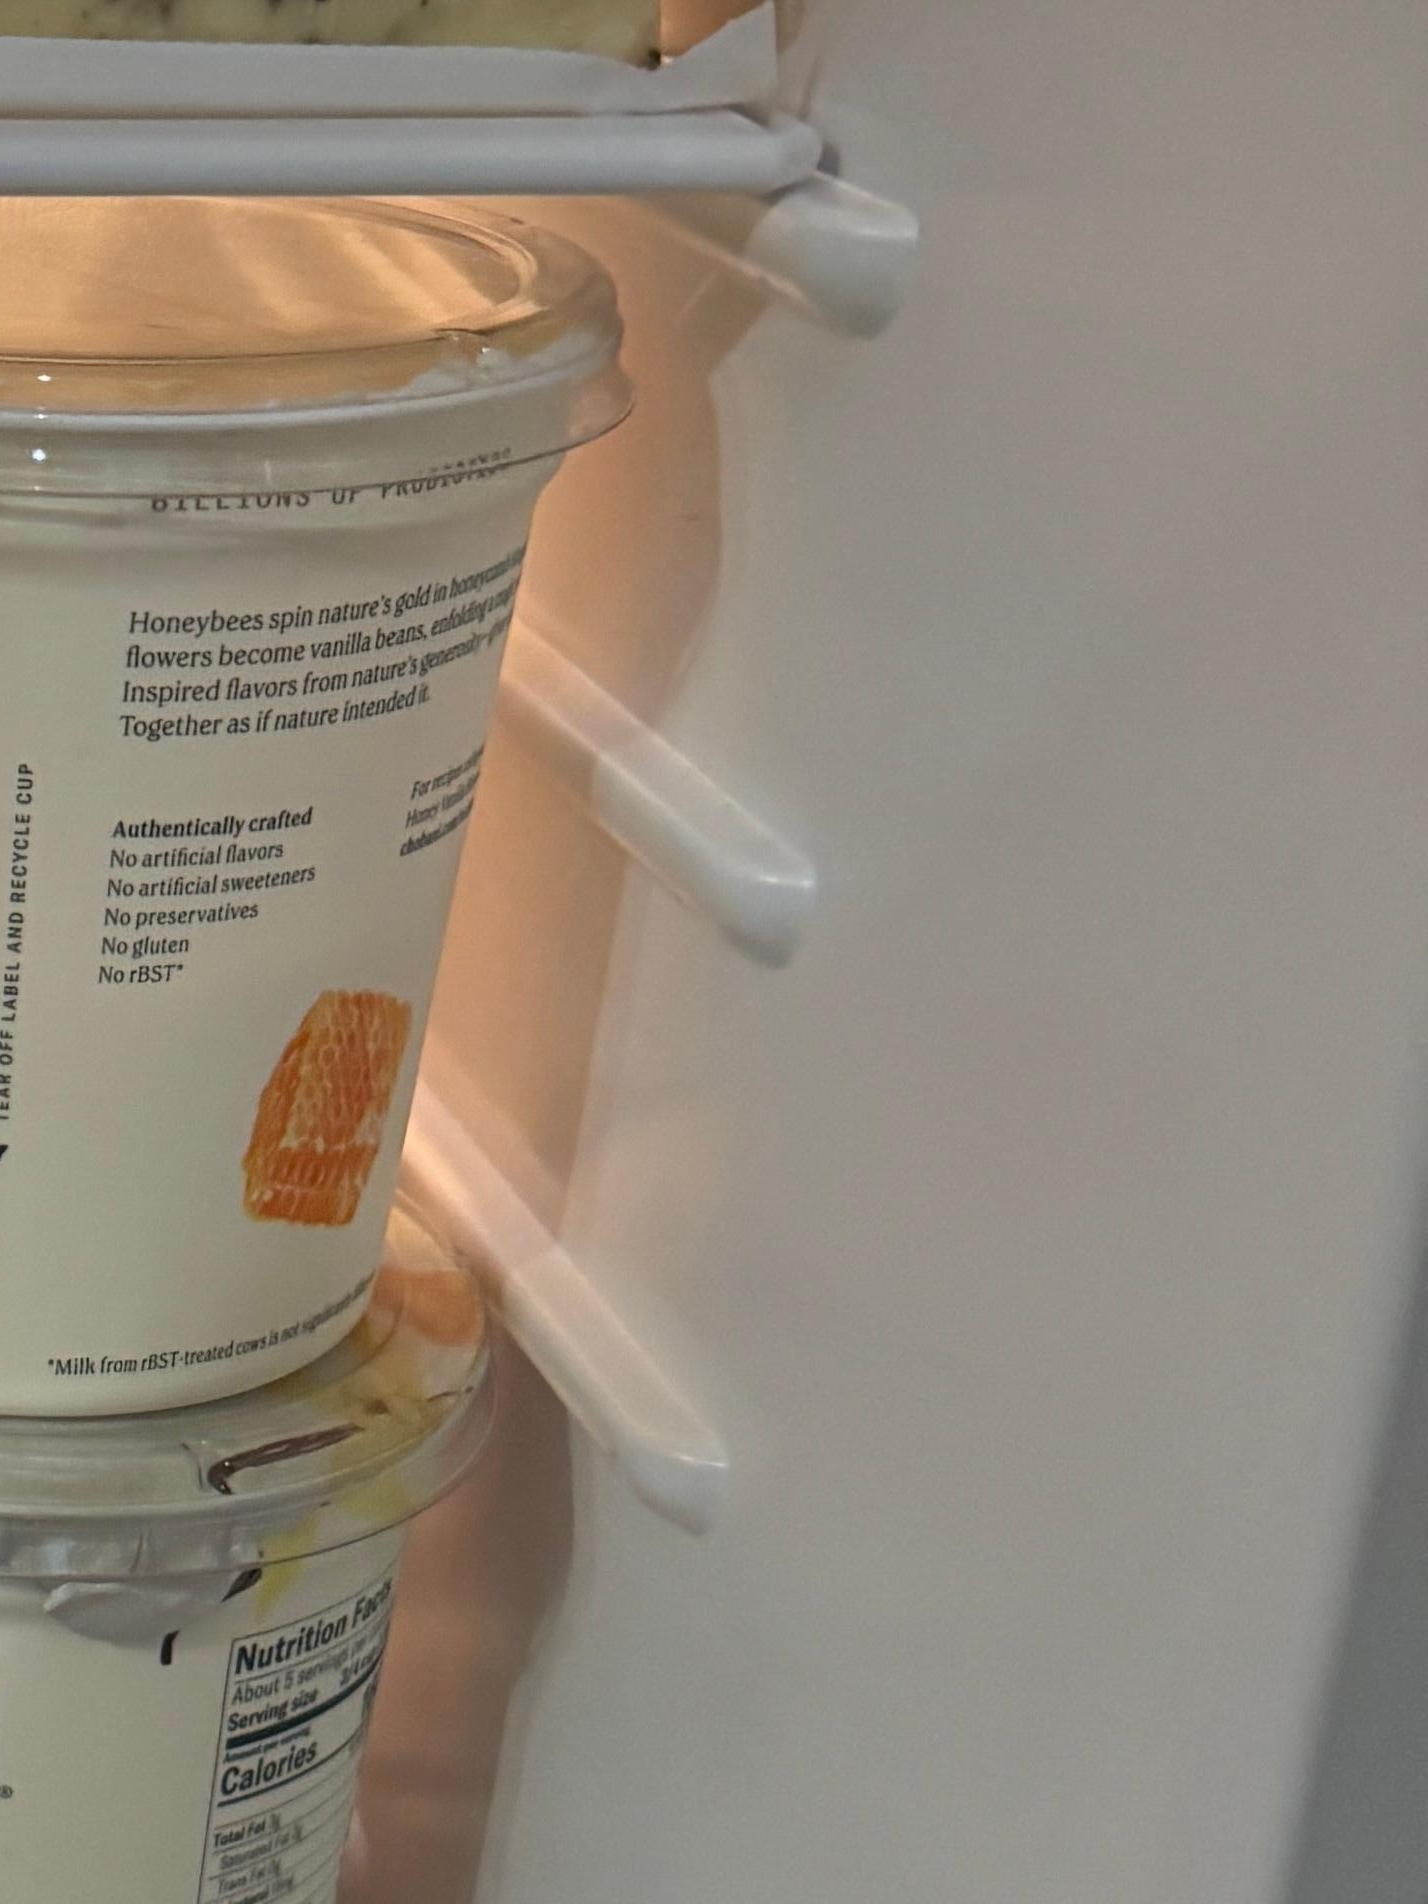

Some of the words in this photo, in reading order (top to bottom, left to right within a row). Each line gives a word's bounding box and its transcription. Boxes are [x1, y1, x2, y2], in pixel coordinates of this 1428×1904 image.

[128, 609, 263, 637] Honeybees
[269, 607, 312, 634] spin
[318, 595, 392, 625] nature's
[394, 585, 430, 617] gold
[126, 646, 212, 669] flowers
[218, 638, 305, 667] become
[311, 631, 371, 658] vanilla
[375, 620, 428, 650] beans,
[122, 679, 220, 707] Inspired
[225, 674, 298, 700] flavors
[302, 669, 348, 698] from
[351, 648, 417, 688] nature's
[120, 713, 222, 742] Together
[227, 713, 250, 734] as
[255, 707, 272, 734] if
[274, 706, 338, 730] nature
[343, 687, 416, 723] intended
[17, 763, 33, 805] CUP
[112, 815, 245, 840] Authentically
[249, 806, 313, 833] crafted
[11, 814, 31, 903] RECYCLE
[110, 849, 138, 868] No
[141, 843, 221, 868] artificial
[225, 841, 284, 863] flavors
[107, 879, 134, 898] No
[139, 873, 217, 897] artificial
[221, 865, 316, 892] sweeteners
[7, 912, 23, 953] AND
[104, 908, 131, 927] No
[135, 902, 259, 931] preservatives
[102, 938, 128, 955] No
[132, 935, 189, 960] gluten
[1, 961, 20, 1023] LABEL
[98, 966, 125, 984] No
[0, 1030, 13, 1065] OFF
[100, 1357, 138, 1374] from
[141, 1340, 235, 1371] rBST-treated
[236, 1335, 266, 1356] cows
[235, 1614, 347, 1674] Nutrition
[352, 1580, 391, 1628] Facts
[232, 1678, 280, 1705] About
[227, 1701, 288, 1731] Serving
[221, 1742, 317, 1796] Calories
